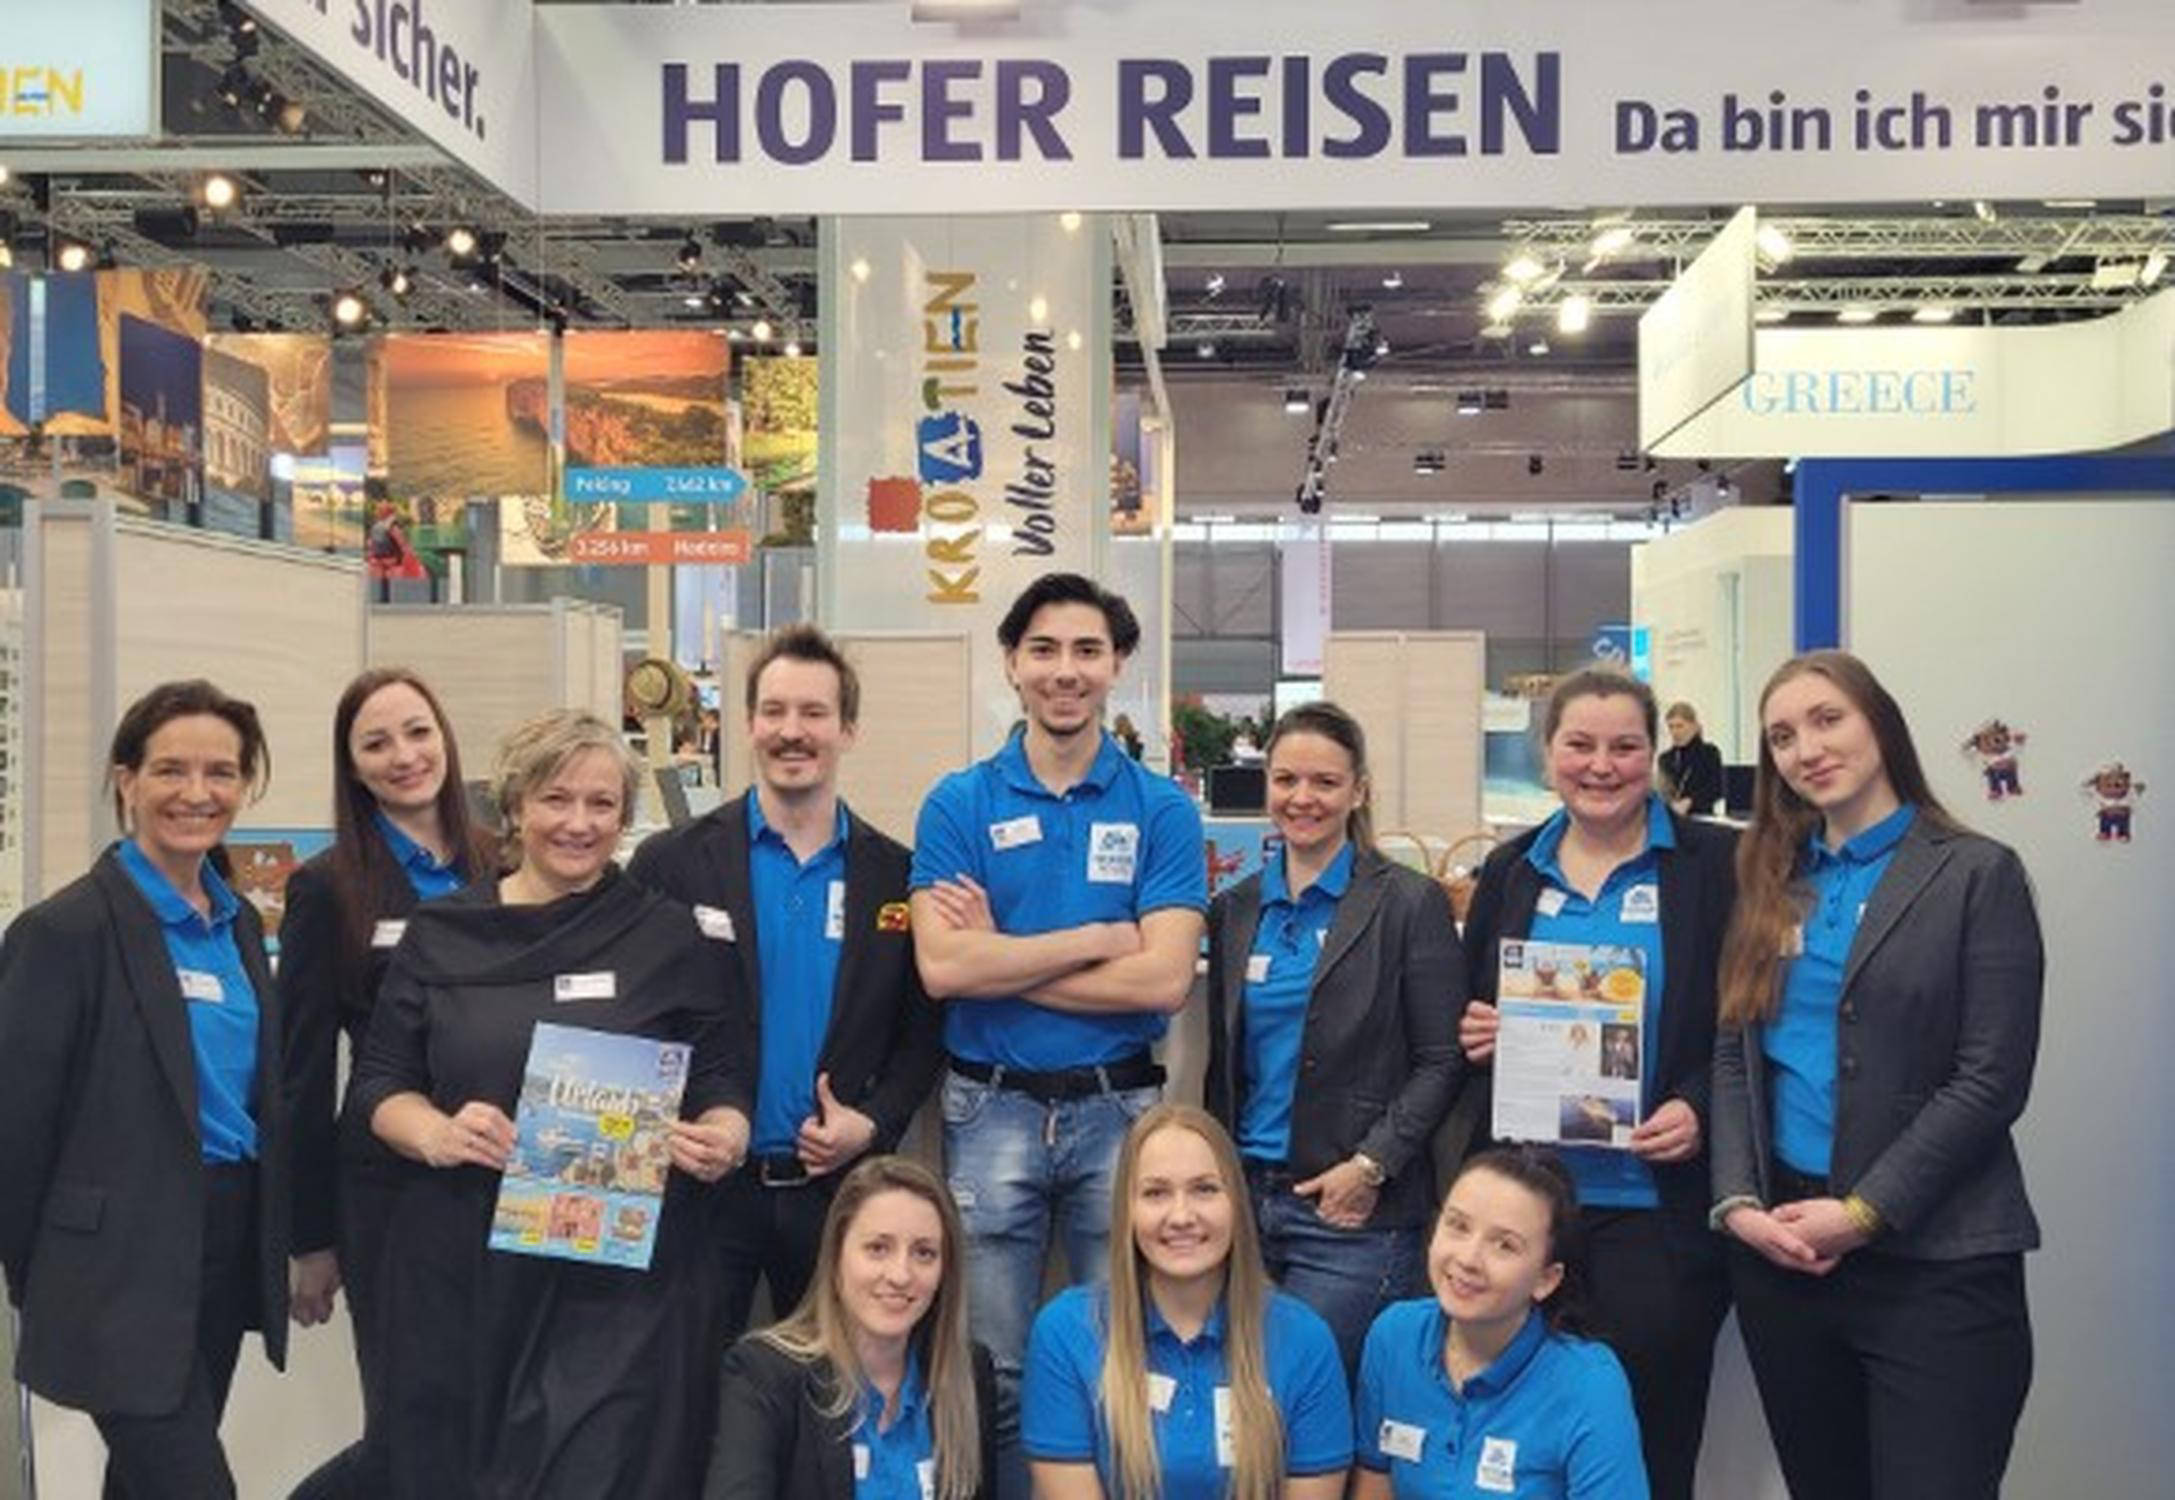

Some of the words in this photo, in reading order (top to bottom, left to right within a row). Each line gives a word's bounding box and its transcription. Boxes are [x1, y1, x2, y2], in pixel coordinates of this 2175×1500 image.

[661, 59, 1073, 165] HOFER
[1117, 51, 1561, 160] REISEN
[1615, 100, 1700, 154] Da
[1722, 89, 1831, 152] bin
[1855, 88, 1952, 150] ich
[1975, 85, 2094, 148] mir
[2112, 83, 2175, 146] si
[920, 272, 982, 604] KROATIEN
[1003, 329, 1056, 440] Leben
[1743, 369, 1977, 415] GREECE
[1005, 446, 1056, 557] Voller
